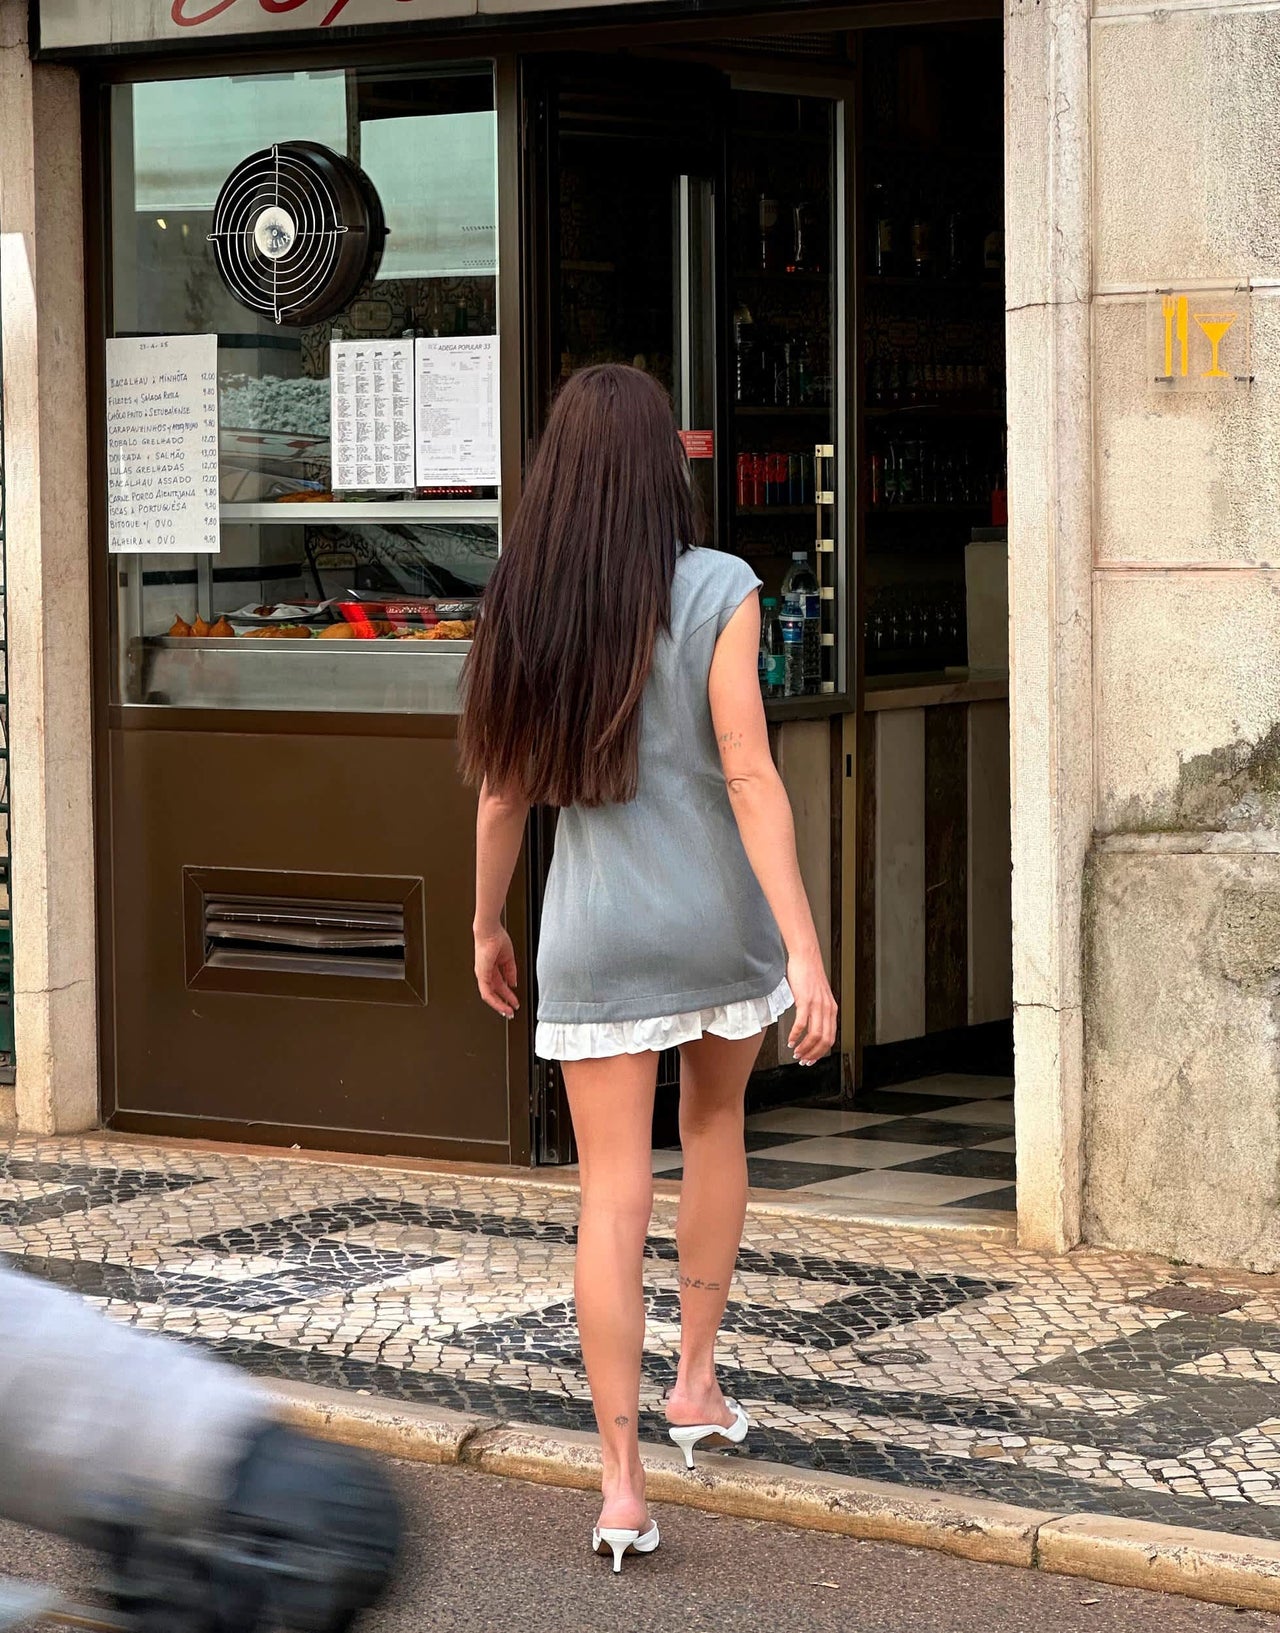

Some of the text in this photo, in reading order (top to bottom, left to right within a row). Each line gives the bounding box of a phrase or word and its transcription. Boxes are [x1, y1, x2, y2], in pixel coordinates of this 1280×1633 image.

[110, 376, 148, 388] BACALHAU
[109, 438, 138, 448] ROBALO
[142, 436, 184, 446] GRELHADO
[155, 449, 185, 460] SALMÃO
[136, 463, 184, 474] GRELHADAS
[108, 478, 152, 488] BACALHAU
[158, 476, 192, 485] ASSADO
[132, 492, 154, 501] PORCO
[110, 519, 140, 529] BITOQUE
[154, 520, 173, 528] OVO
[111, 537, 143, 546] ALHEIRA
[158, 536, 176, 544] OVO
